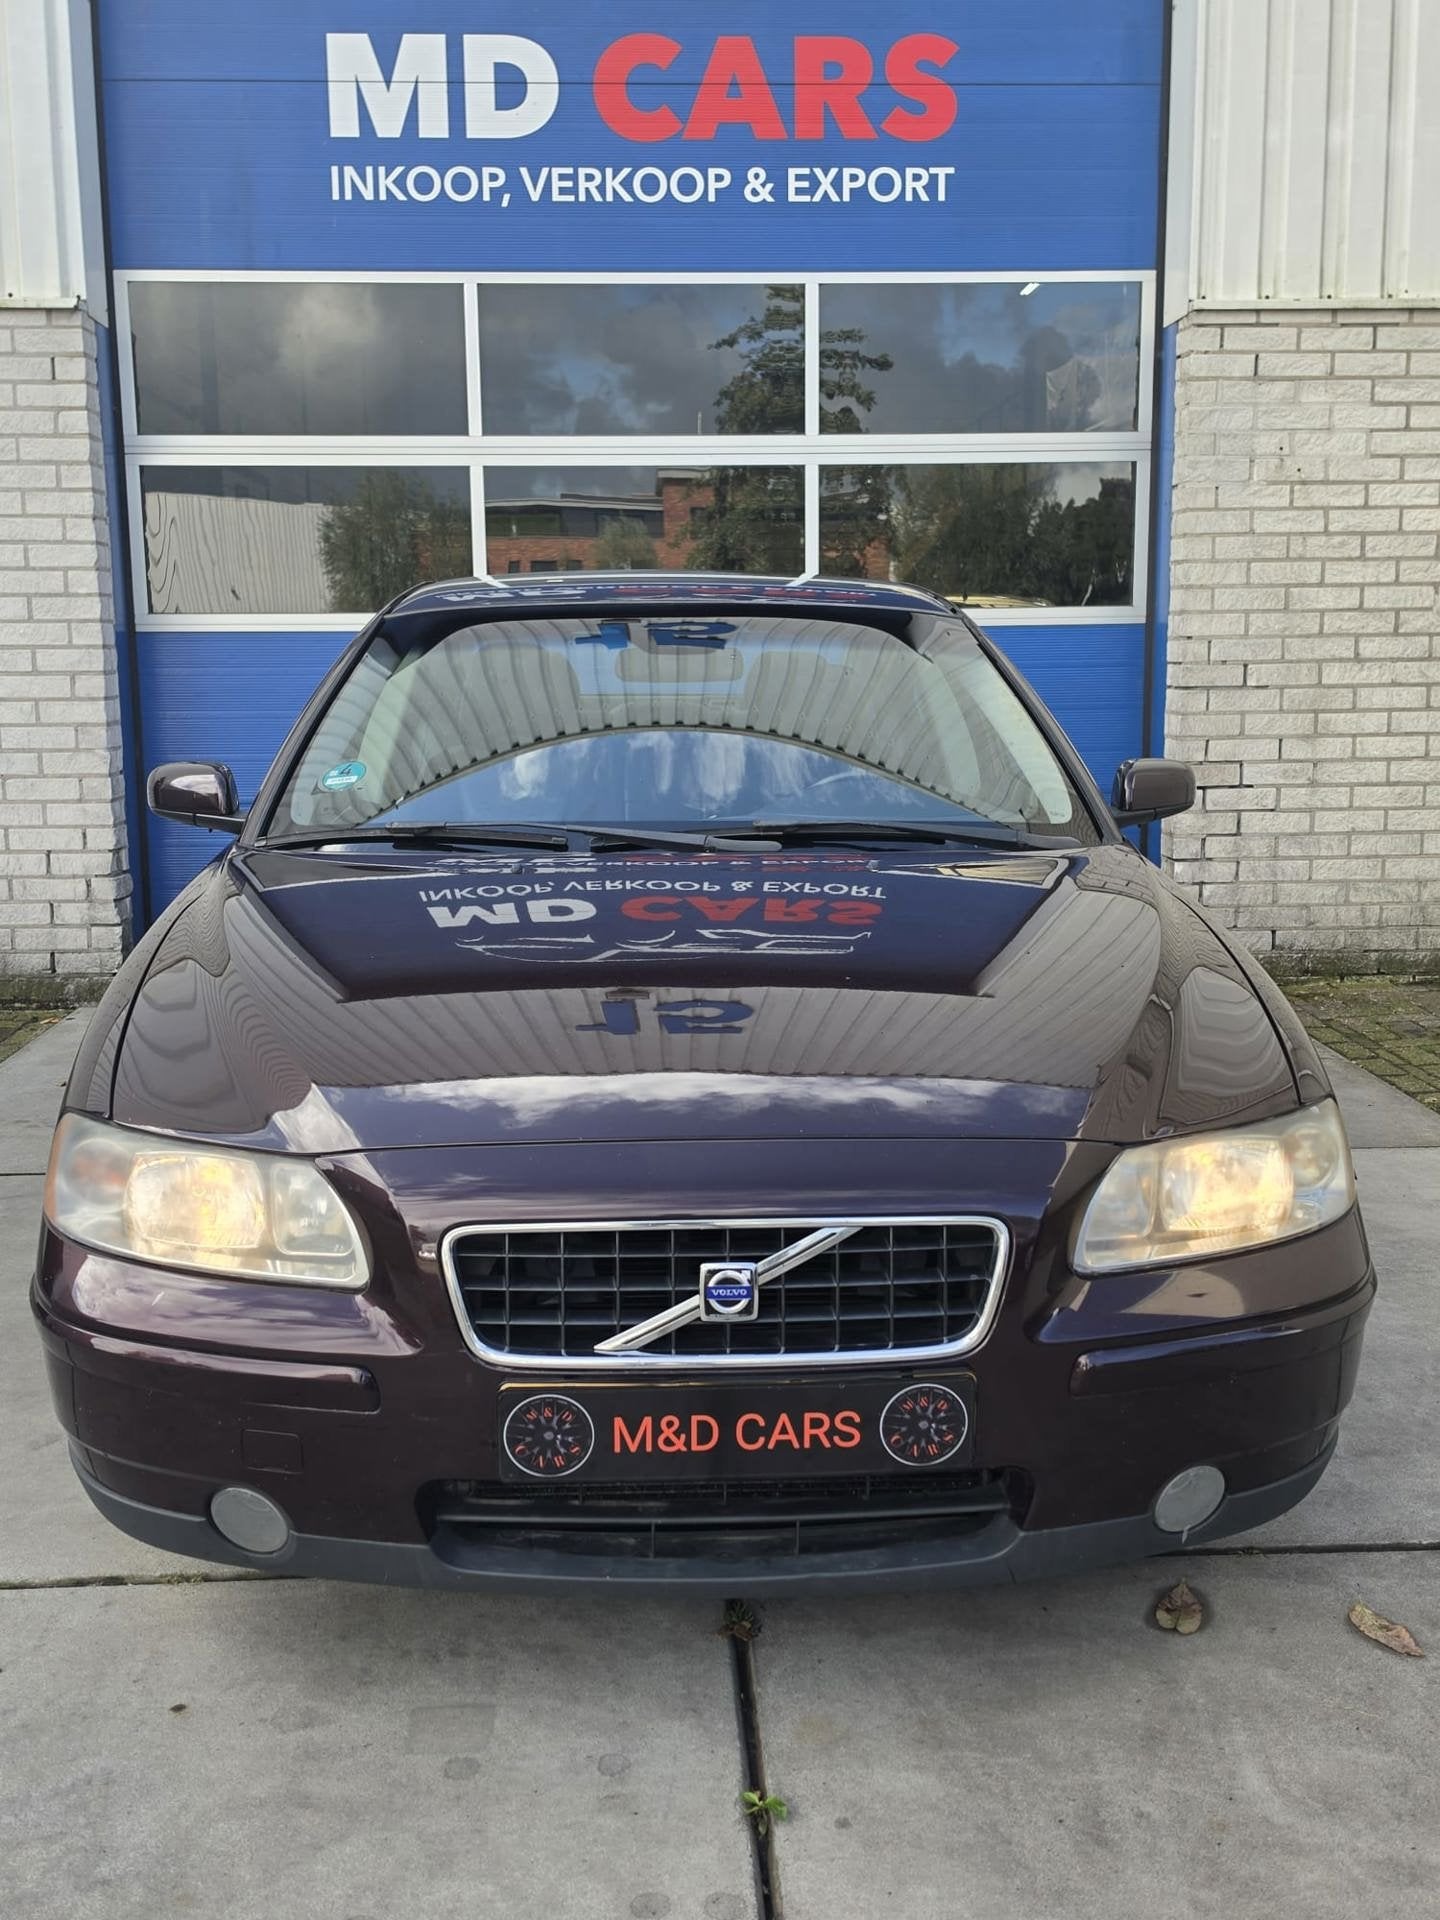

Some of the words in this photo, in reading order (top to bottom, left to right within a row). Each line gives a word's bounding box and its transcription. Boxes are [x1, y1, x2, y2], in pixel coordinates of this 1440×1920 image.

[326, 32, 560, 139] MD
[593, 32, 961, 142] CARS
[330, 165, 511, 207] INKOOP,
[519, 166, 732, 203] VERKOOP
[743, 166, 775, 203] &
[787, 166, 955, 203] EXPORT
[711, 1288, 748, 1297] VOLVO
[612, 1413, 719, 1454] M&D
[735, 1410, 861, 1451] CARS
